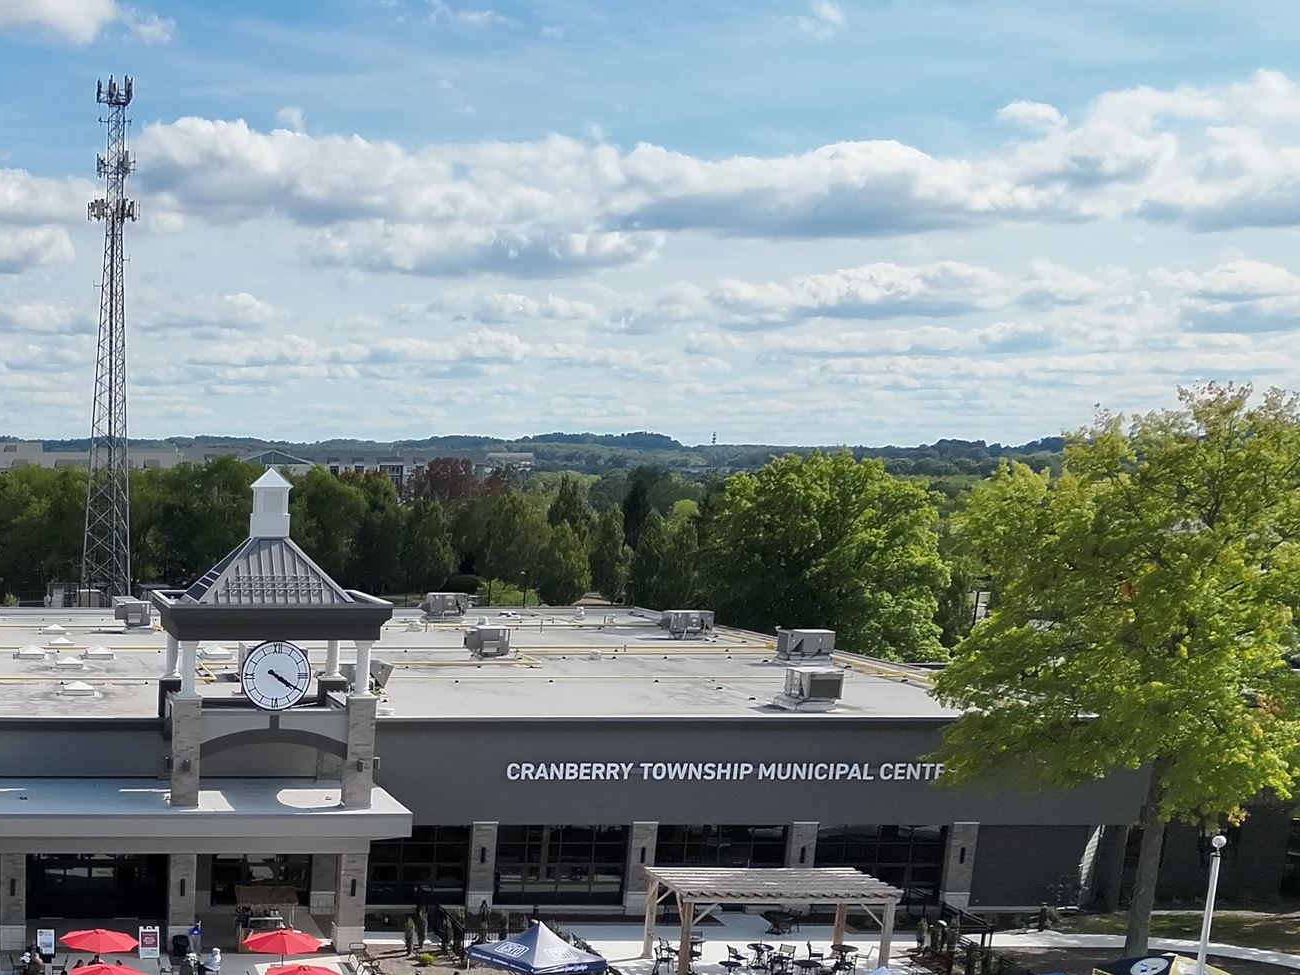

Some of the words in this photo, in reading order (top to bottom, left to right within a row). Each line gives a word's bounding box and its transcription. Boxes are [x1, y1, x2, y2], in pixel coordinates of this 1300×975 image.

[506, 762, 634, 780] CRANBERRY
[639, 762, 754, 780] TOWNSHIP
[757, 762, 875, 780] MUNICIPAL
[879, 762, 947, 780] CENTE
